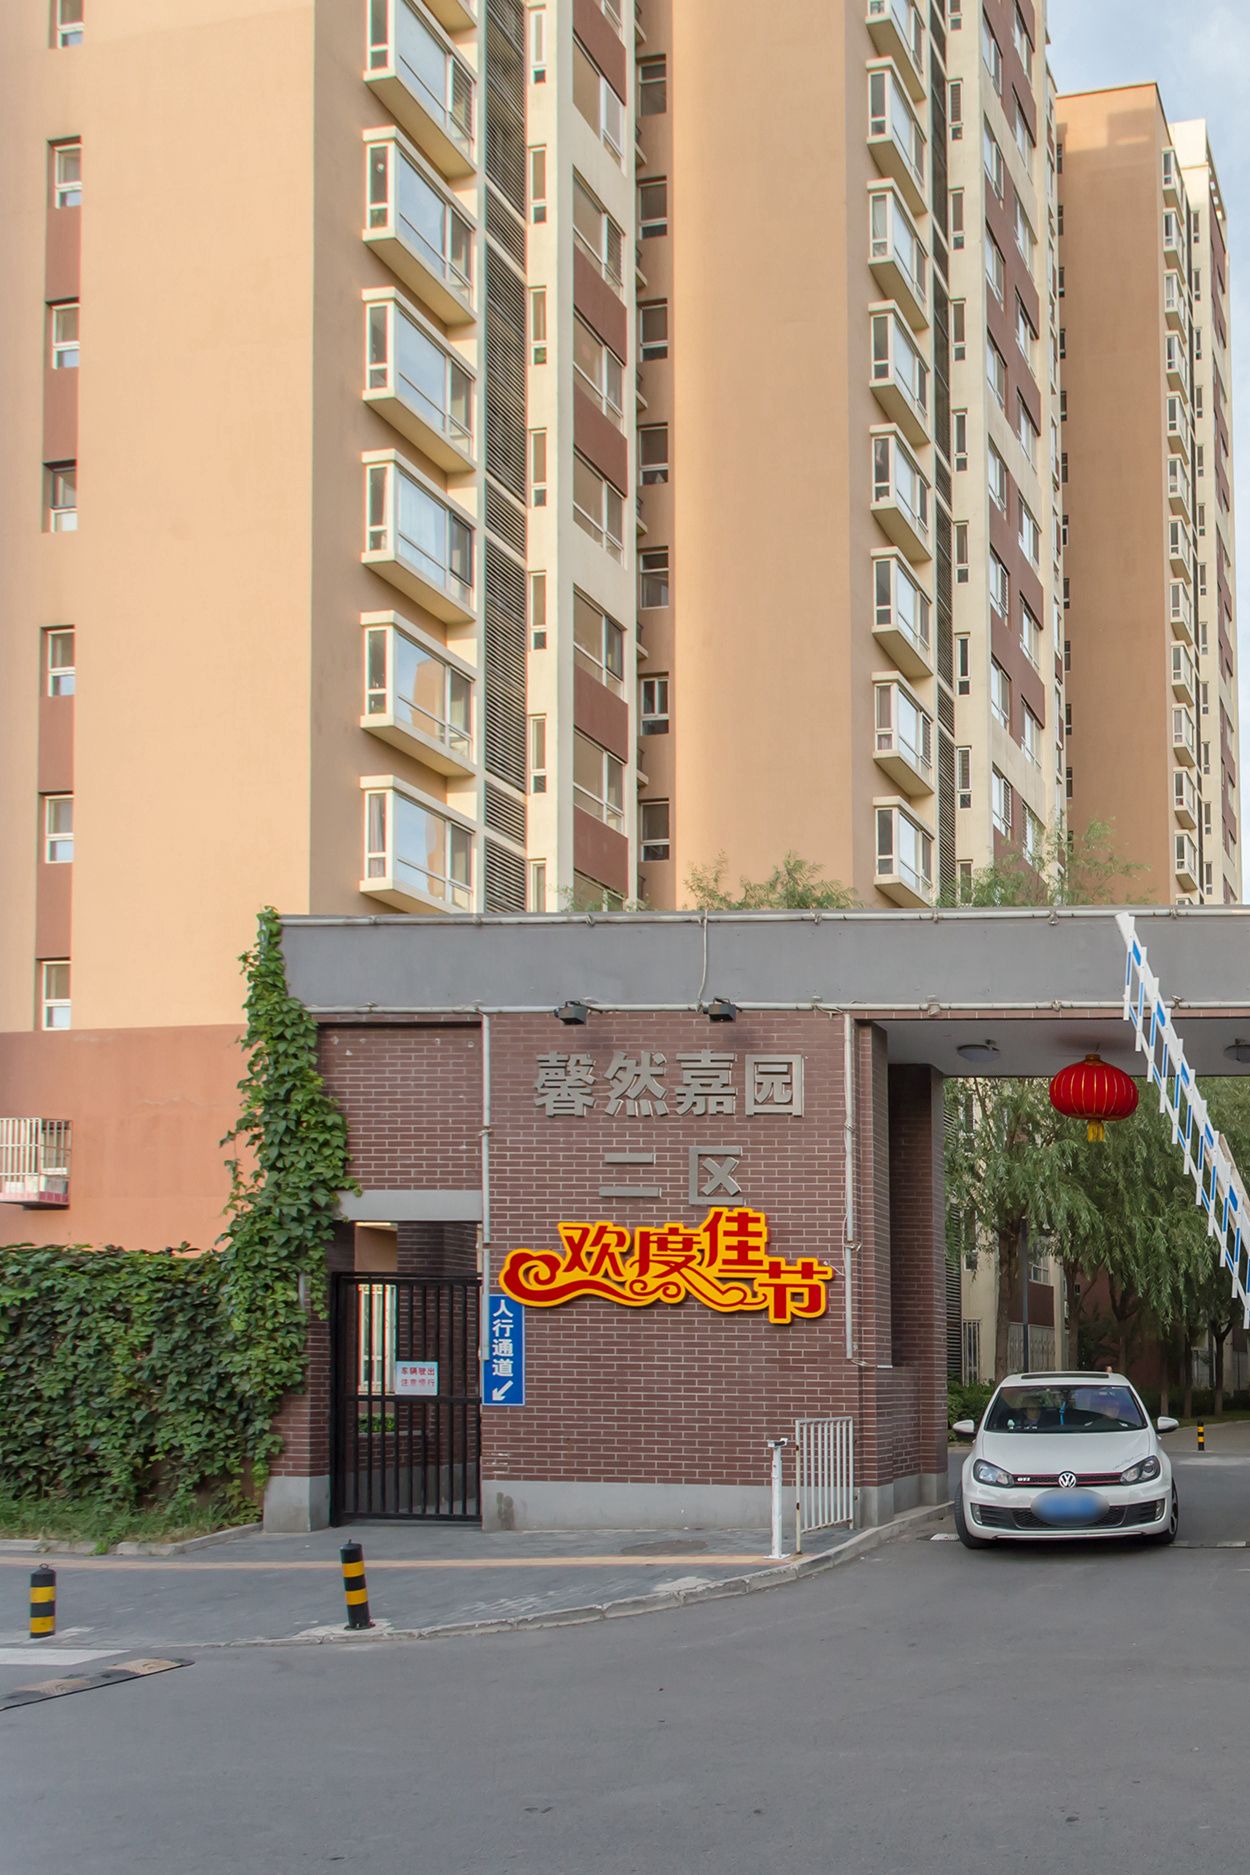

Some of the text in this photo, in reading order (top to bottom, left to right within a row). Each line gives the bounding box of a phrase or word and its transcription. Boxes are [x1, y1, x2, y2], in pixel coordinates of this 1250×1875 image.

[534, 1049, 806, 1118] 馨然嘉园
[599, 1146, 748, 1207] 二区
[560, 1210, 832, 1319] 欢度佳节
[400, 1366, 436, 1377] 车辆驶出
[491, 1299, 515, 1378] 人行通道
